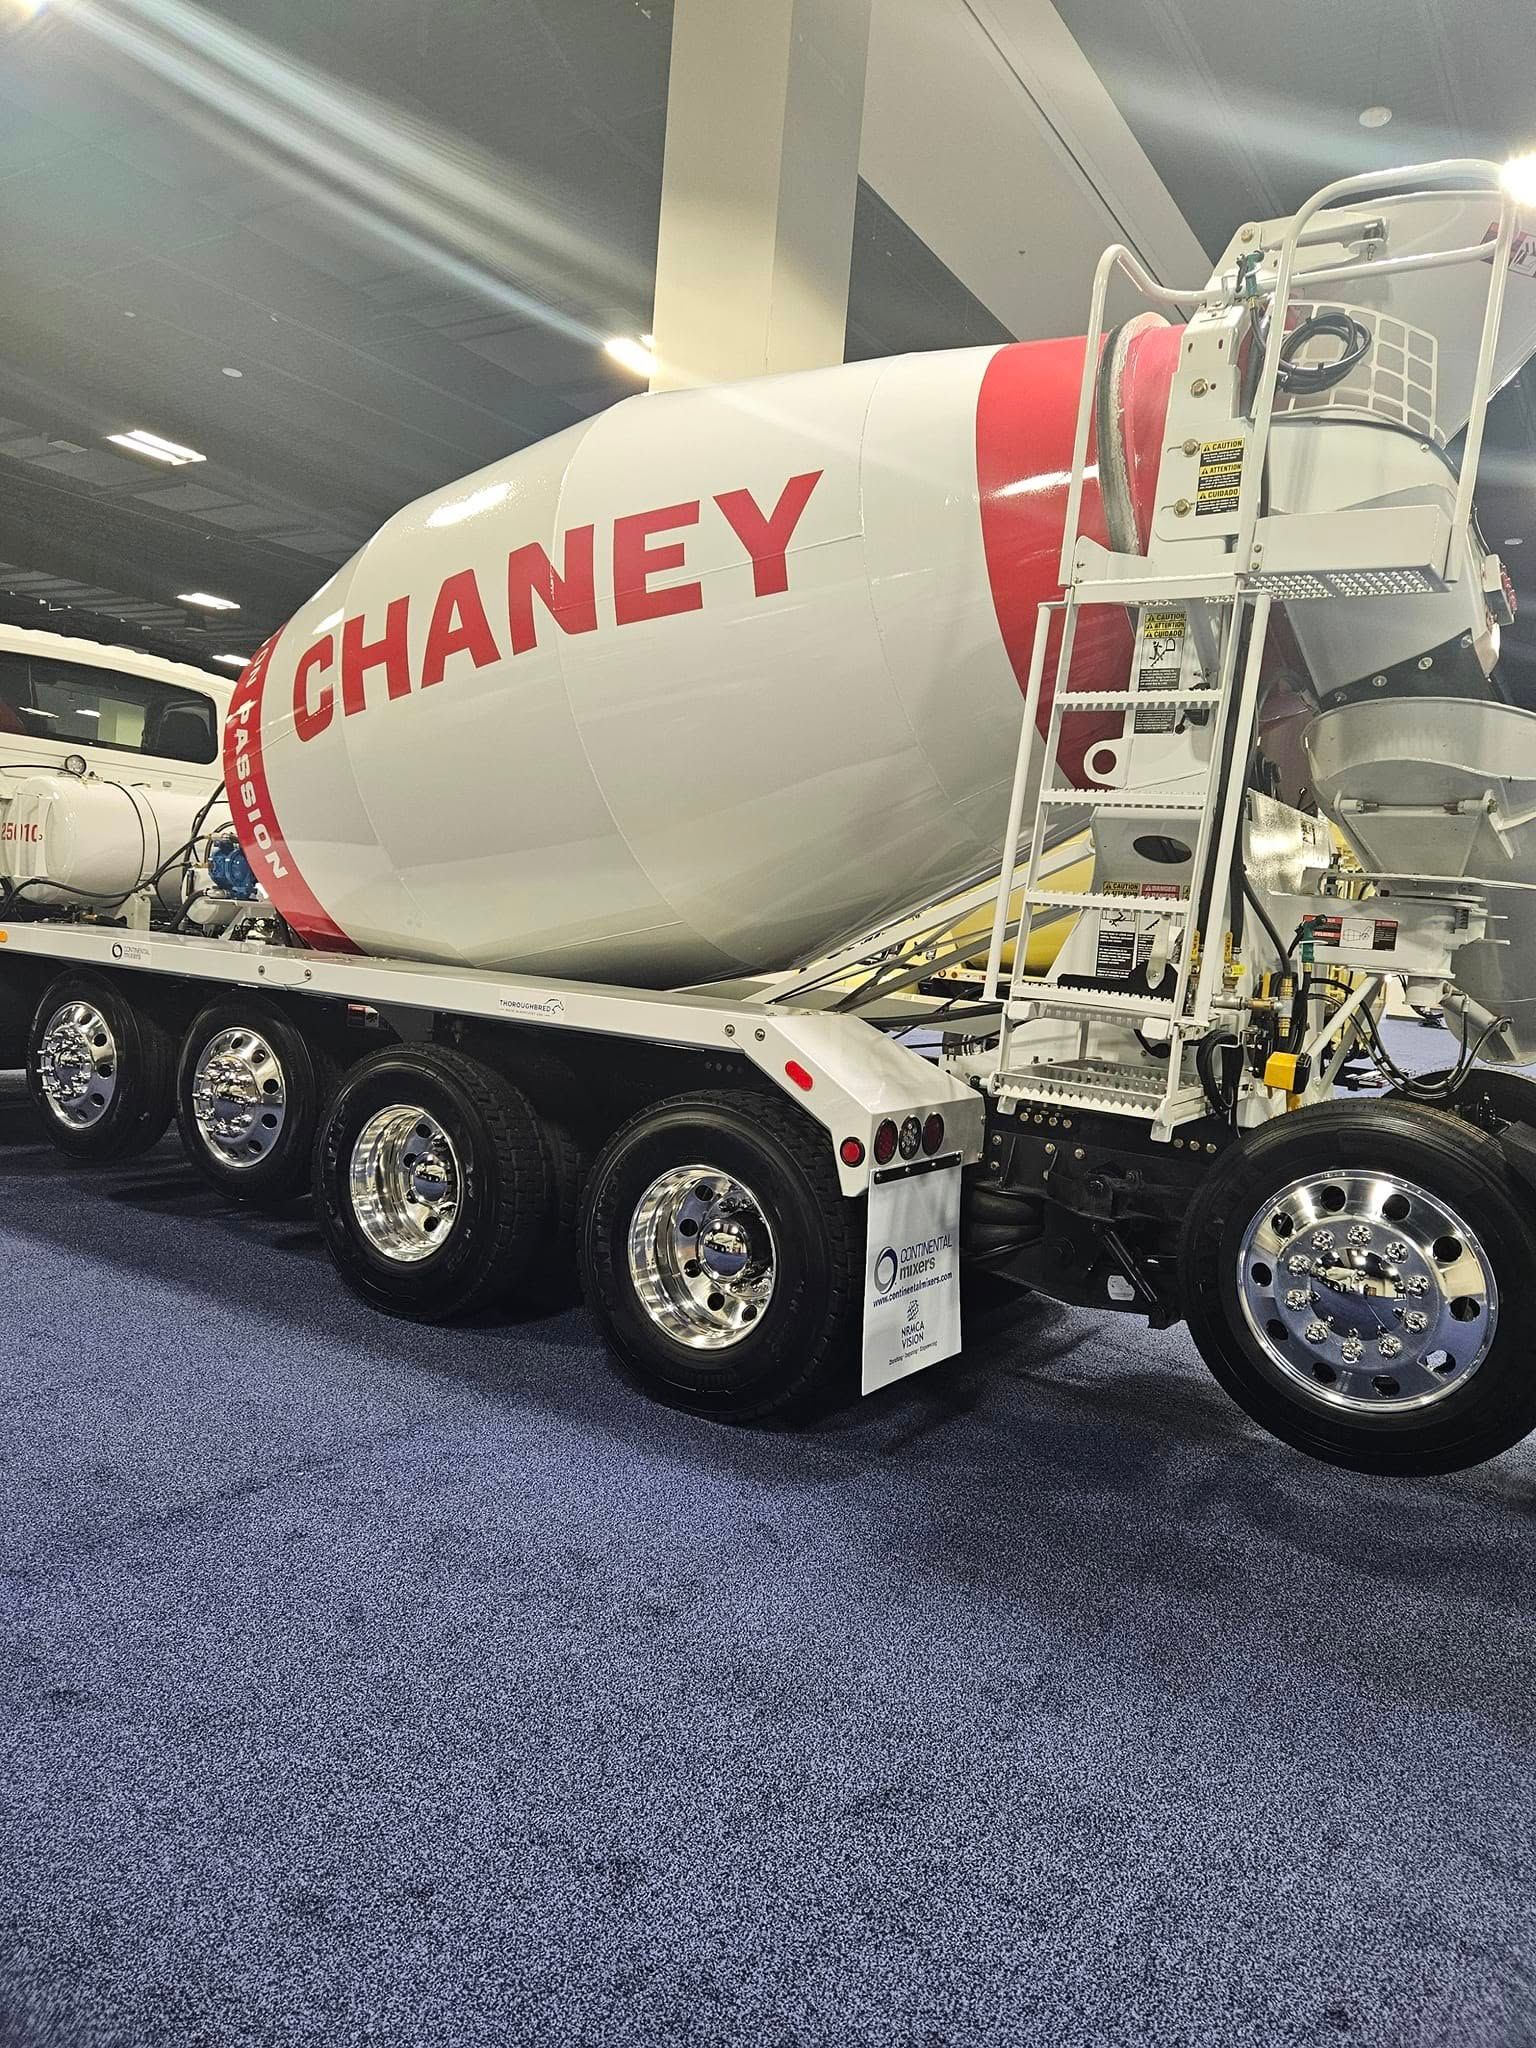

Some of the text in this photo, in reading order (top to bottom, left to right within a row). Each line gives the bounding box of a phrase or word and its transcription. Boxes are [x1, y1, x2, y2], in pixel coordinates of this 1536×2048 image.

[1212, 440, 1242, 450] CAUTION
[1209, 464, 1241, 473] ATTENTION
[1207, 488, 1238, 498] CUIDADO
[292, 469, 825, 743] CHANEY
[1156, 613, 1185, 621] CAUTION
[1153, 630, 1183, 638] CUIDADO
[234, 698, 289, 880] PASSION
[1112, 882, 1139, 890] CAUTION
[500, 999, 552, 1012] THOROUGHBRED
[900, 1233, 953, 1264] CONTINENTAL
[900, 1256, 937, 1280] mixers
[872, 1271, 953, 1308] www.continentalmixers.com
[901, 1320, 924, 1337] NRMCA
[901, 1331, 924, 1350] VISION
